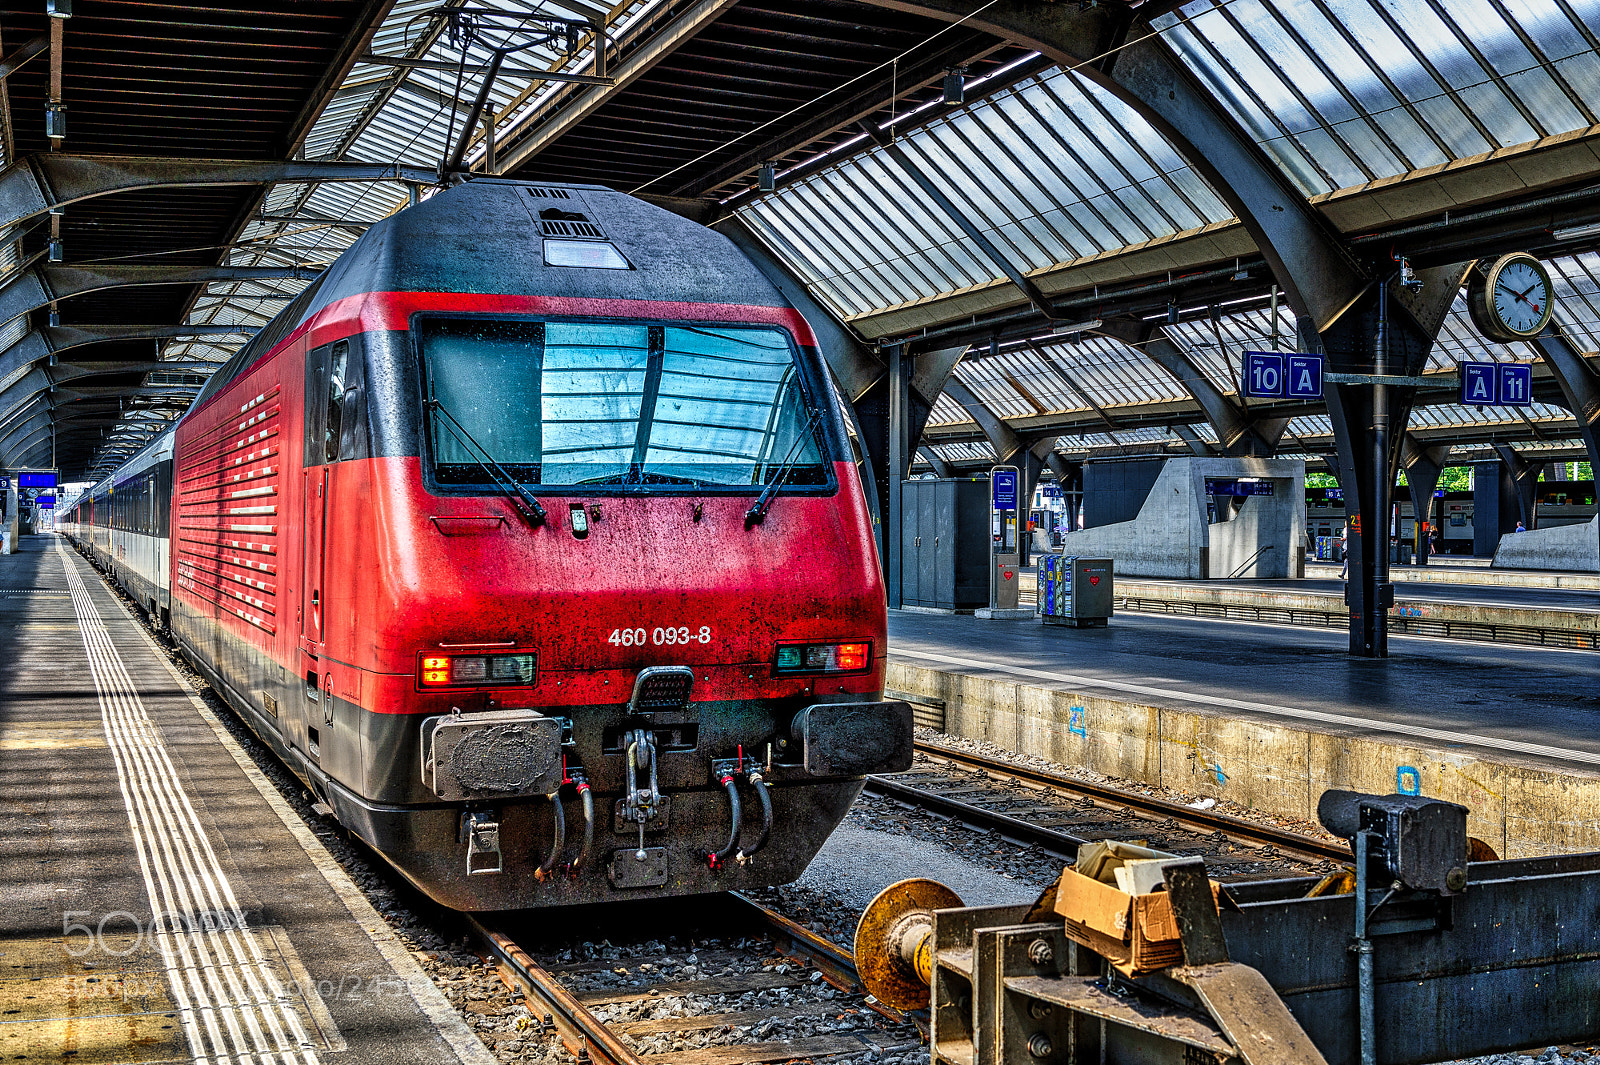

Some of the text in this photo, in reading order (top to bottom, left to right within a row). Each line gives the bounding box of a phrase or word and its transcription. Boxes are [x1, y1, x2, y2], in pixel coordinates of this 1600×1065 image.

[1253, 366, 1278, 390] 10
[1297, 369, 1313, 391] A
[1472, 376, 1488, 398] A
[1507, 377, 1523, 399] 11
[1350, 514, 1356, 525] 2
[608, 625, 711, 647] 460 093-8
